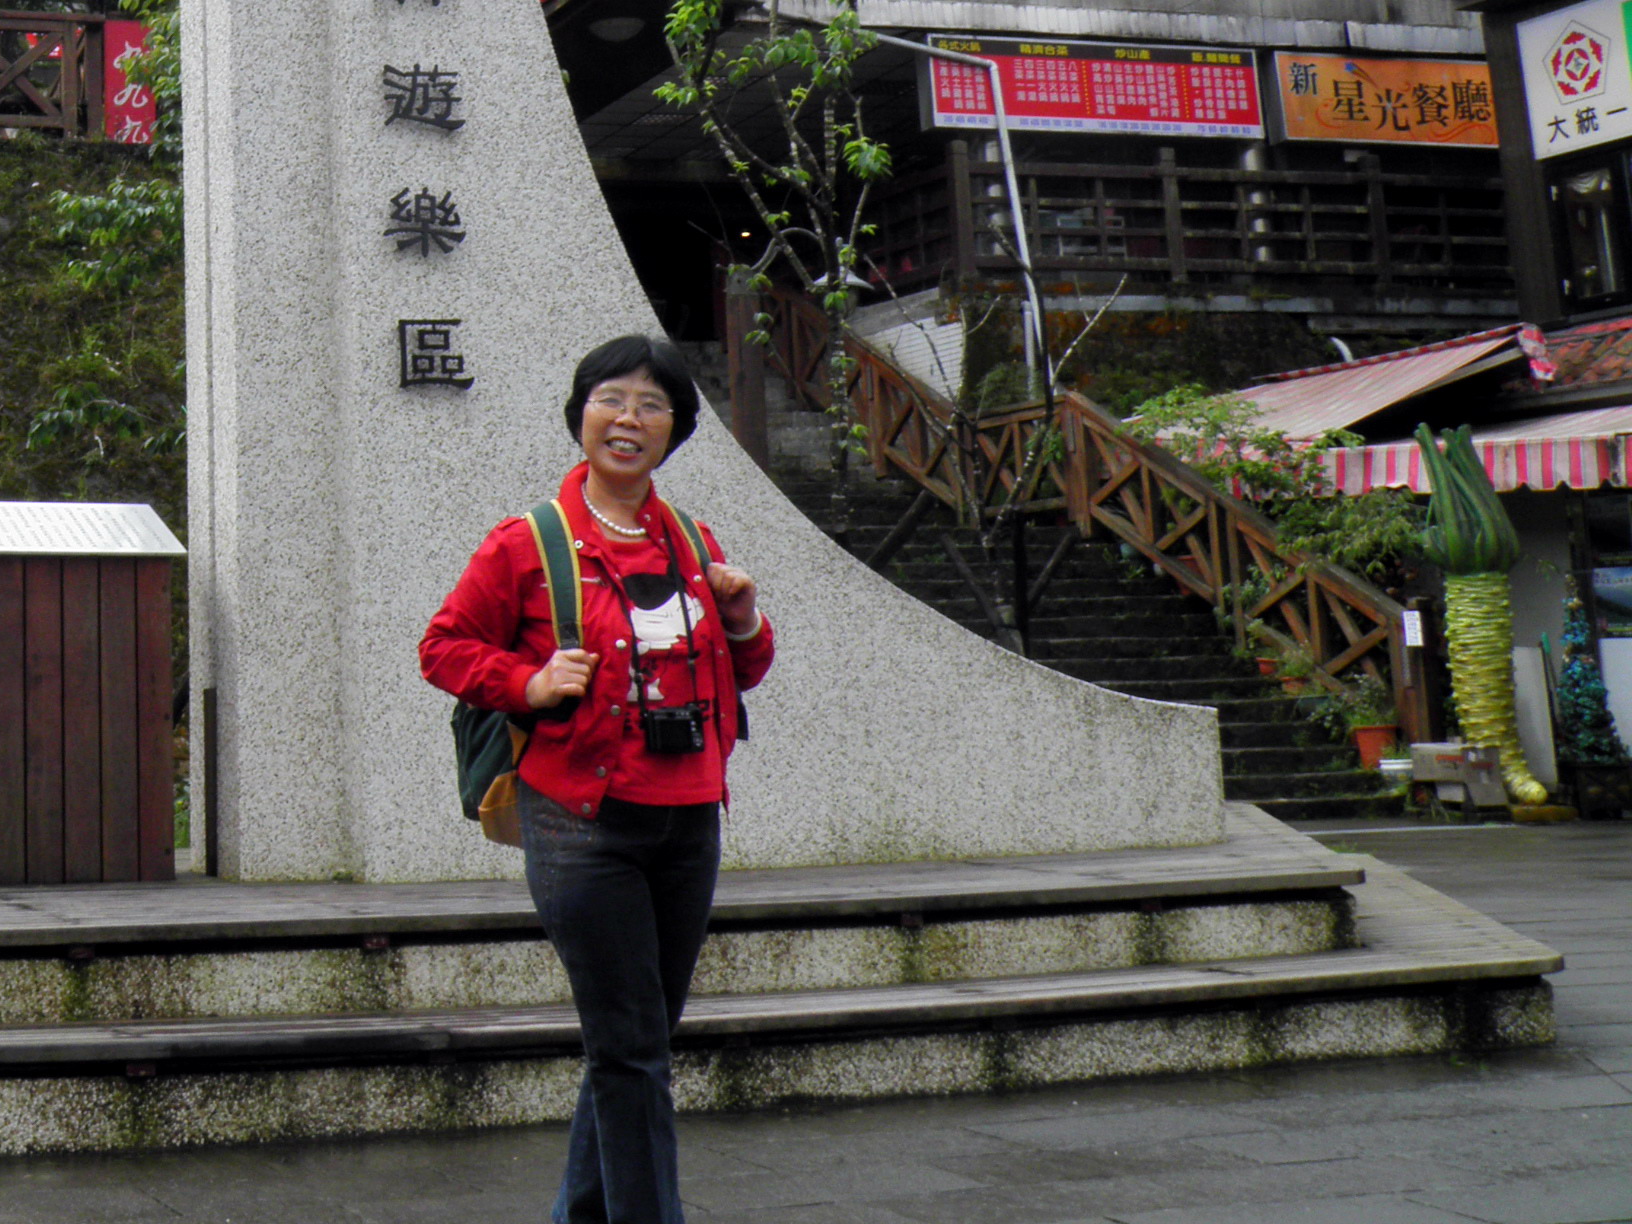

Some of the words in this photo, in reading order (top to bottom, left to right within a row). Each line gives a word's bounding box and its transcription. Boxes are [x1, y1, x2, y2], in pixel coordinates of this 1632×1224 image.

[1288, 62, 1318, 97] 新
[1332, 79, 1492, 131] 星光餐廳
[1547, 106, 1629, 144] 大統一
